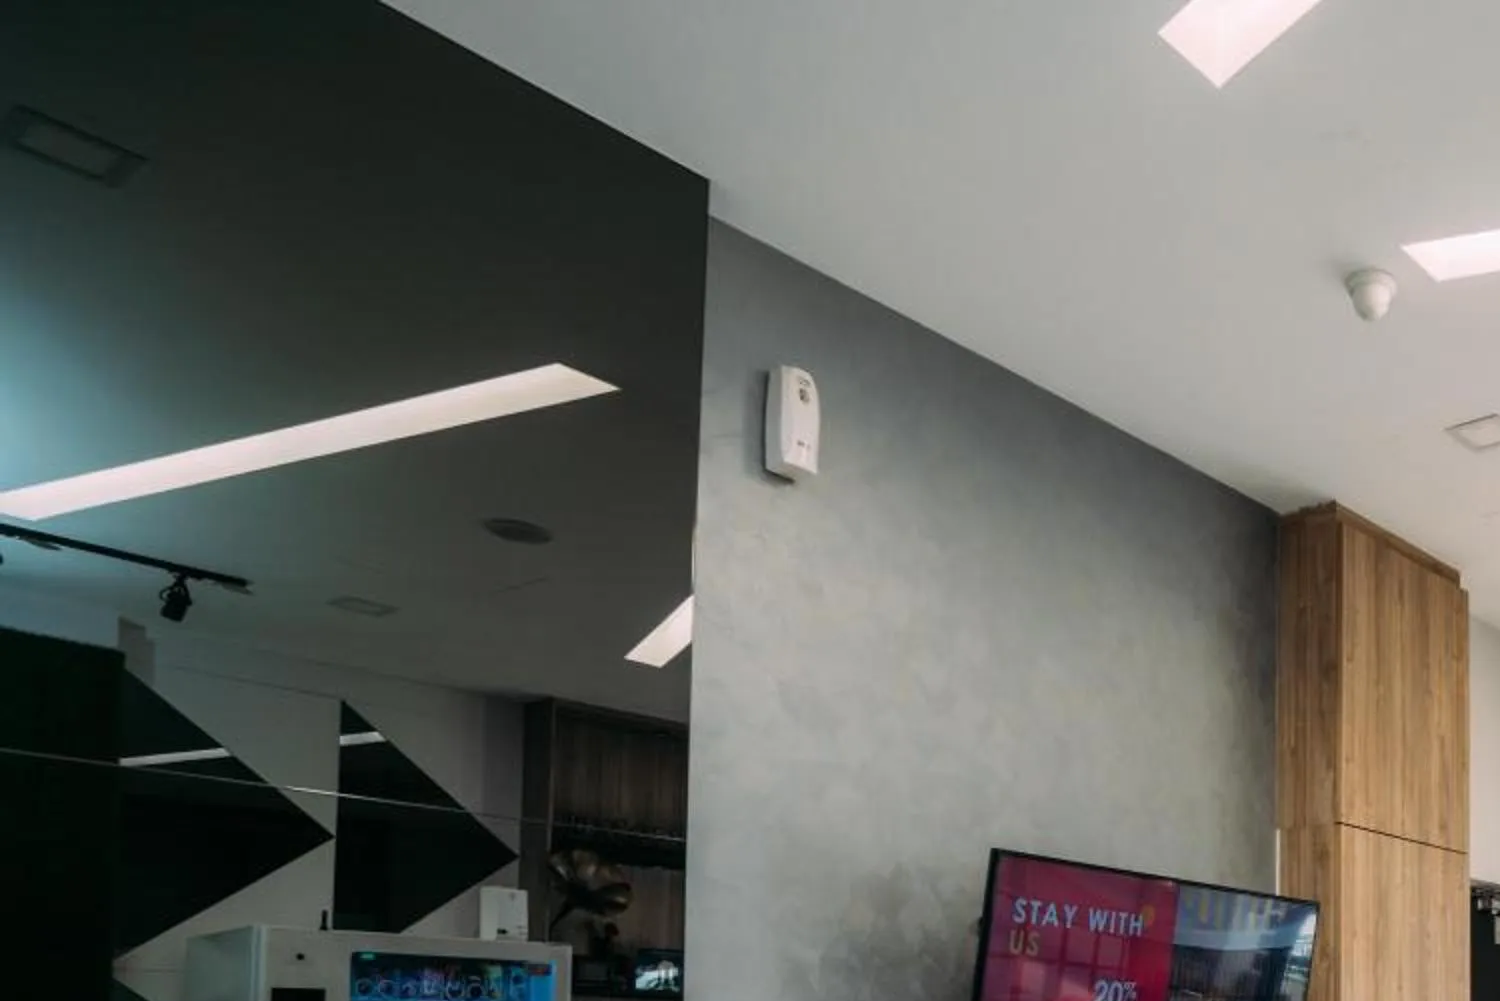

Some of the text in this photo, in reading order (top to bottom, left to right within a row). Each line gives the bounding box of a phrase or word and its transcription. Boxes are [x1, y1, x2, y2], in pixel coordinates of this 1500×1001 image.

[1012, 897, 1078, 928] STAY
[1088, 906, 1144, 936] WITH
[1010, 930, 1039, 956] US
